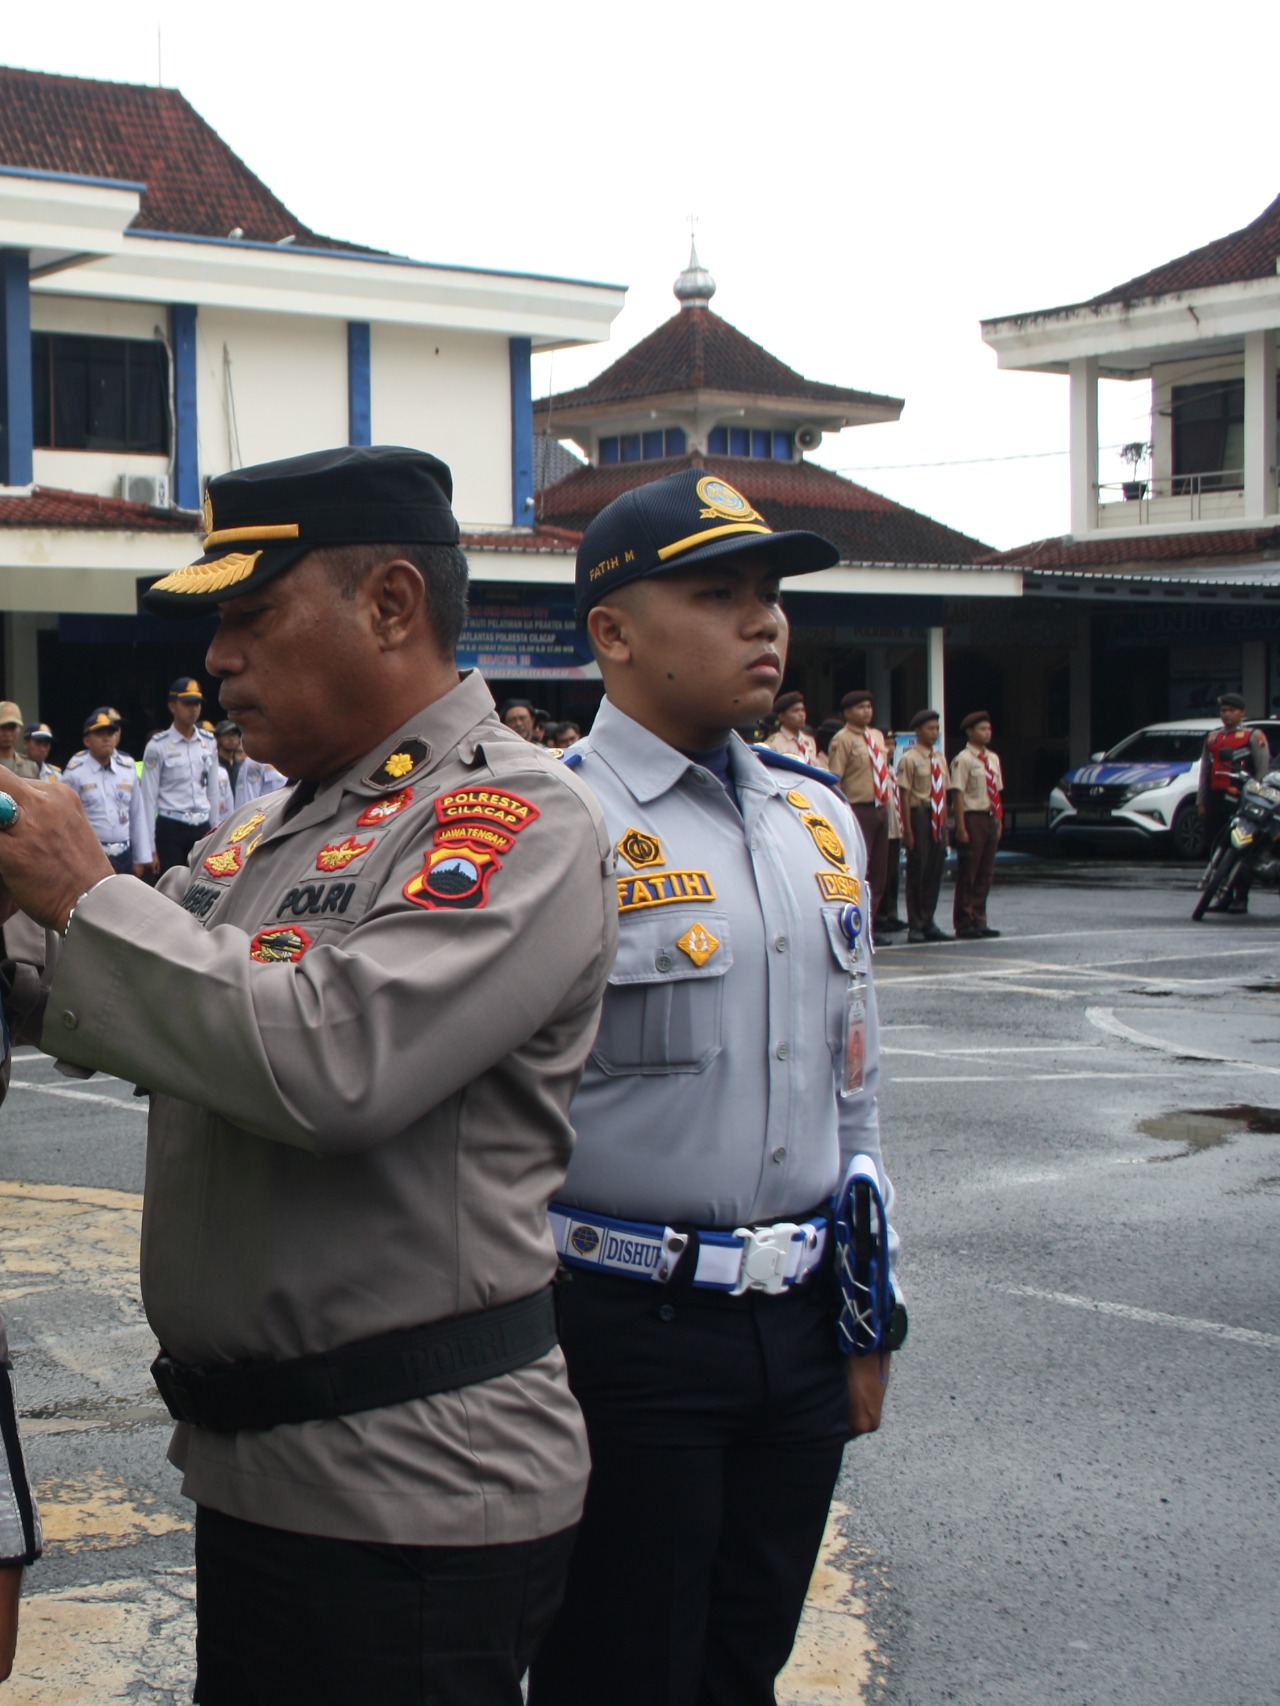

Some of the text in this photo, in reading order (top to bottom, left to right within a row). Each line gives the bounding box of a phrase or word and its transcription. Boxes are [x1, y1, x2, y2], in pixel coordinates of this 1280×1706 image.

[589, 549, 635, 582] FATIH M
[495, 633, 528, 643] POLRESTA
[529, 634, 556, 643] CILACAP
[443, 792, 529, 817] POLRESTA
[447, 806, 517, 824] CILACAP
[439, 828, 507, 847] JAWA TENGAH
[276, 882, 357, 919] POLRI
